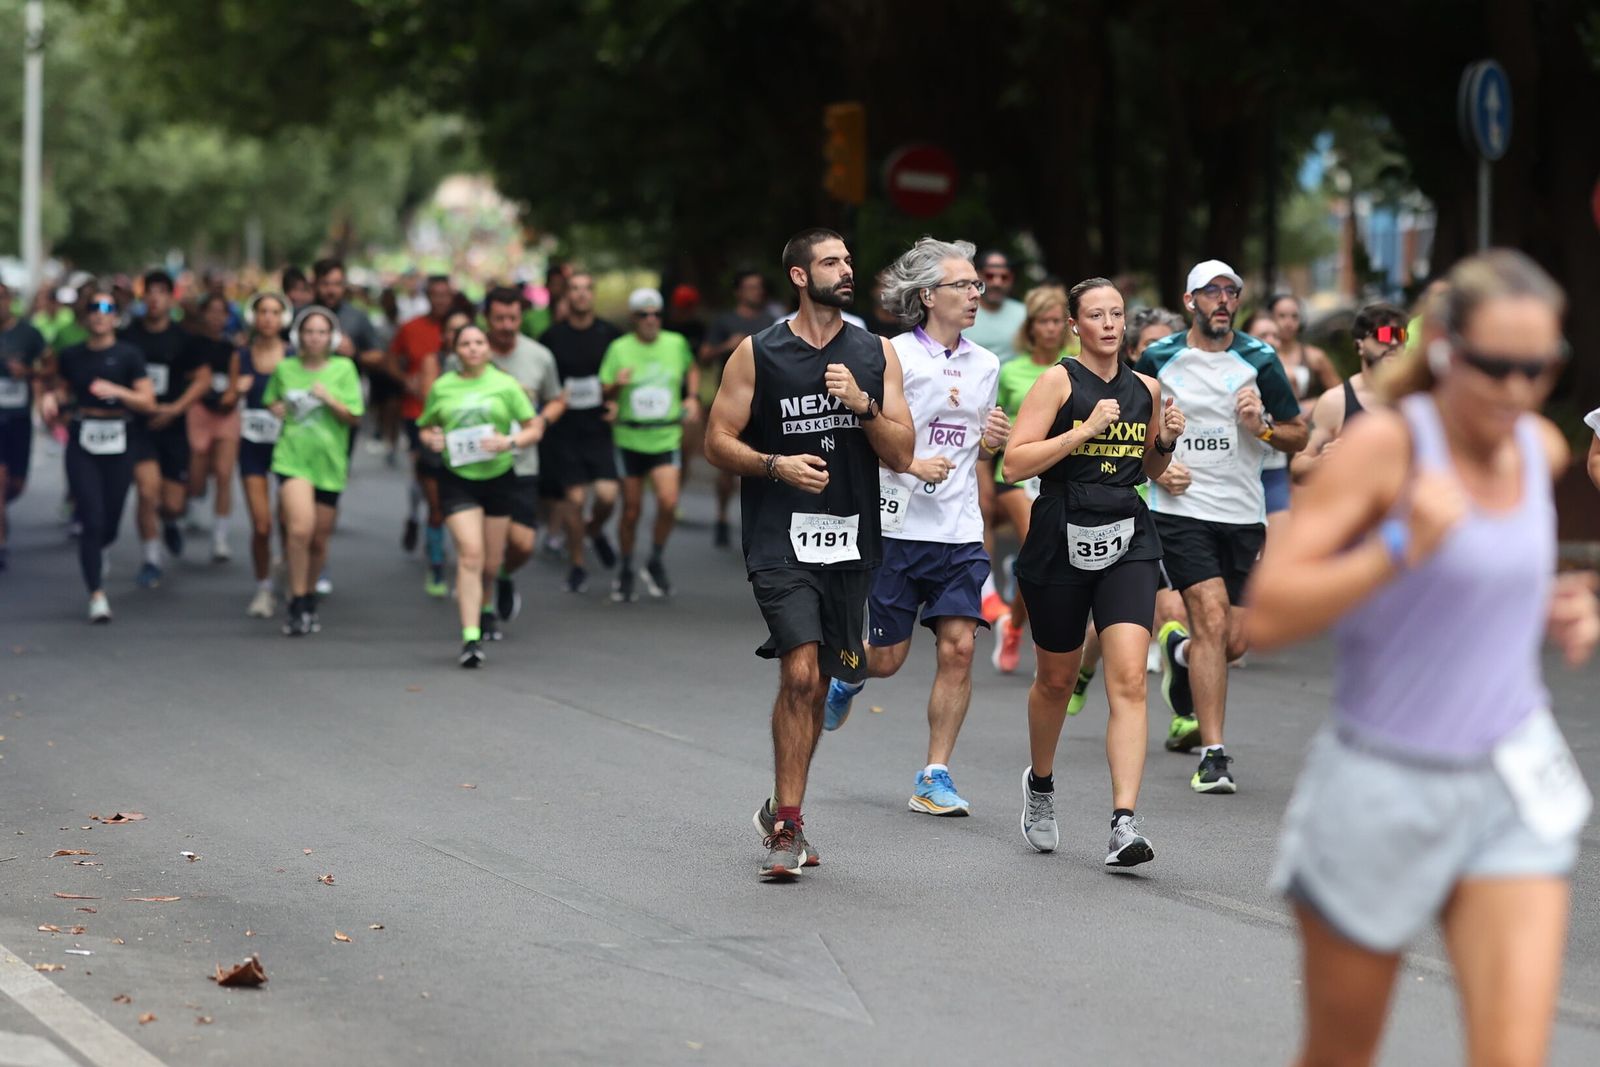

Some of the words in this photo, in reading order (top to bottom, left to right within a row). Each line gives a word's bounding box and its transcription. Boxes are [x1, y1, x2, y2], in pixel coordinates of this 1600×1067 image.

[1183, 438, 1230, 450] 1085
[797, 532, 848, 547] 1191
[1077, 536, 1122, 557] 351
